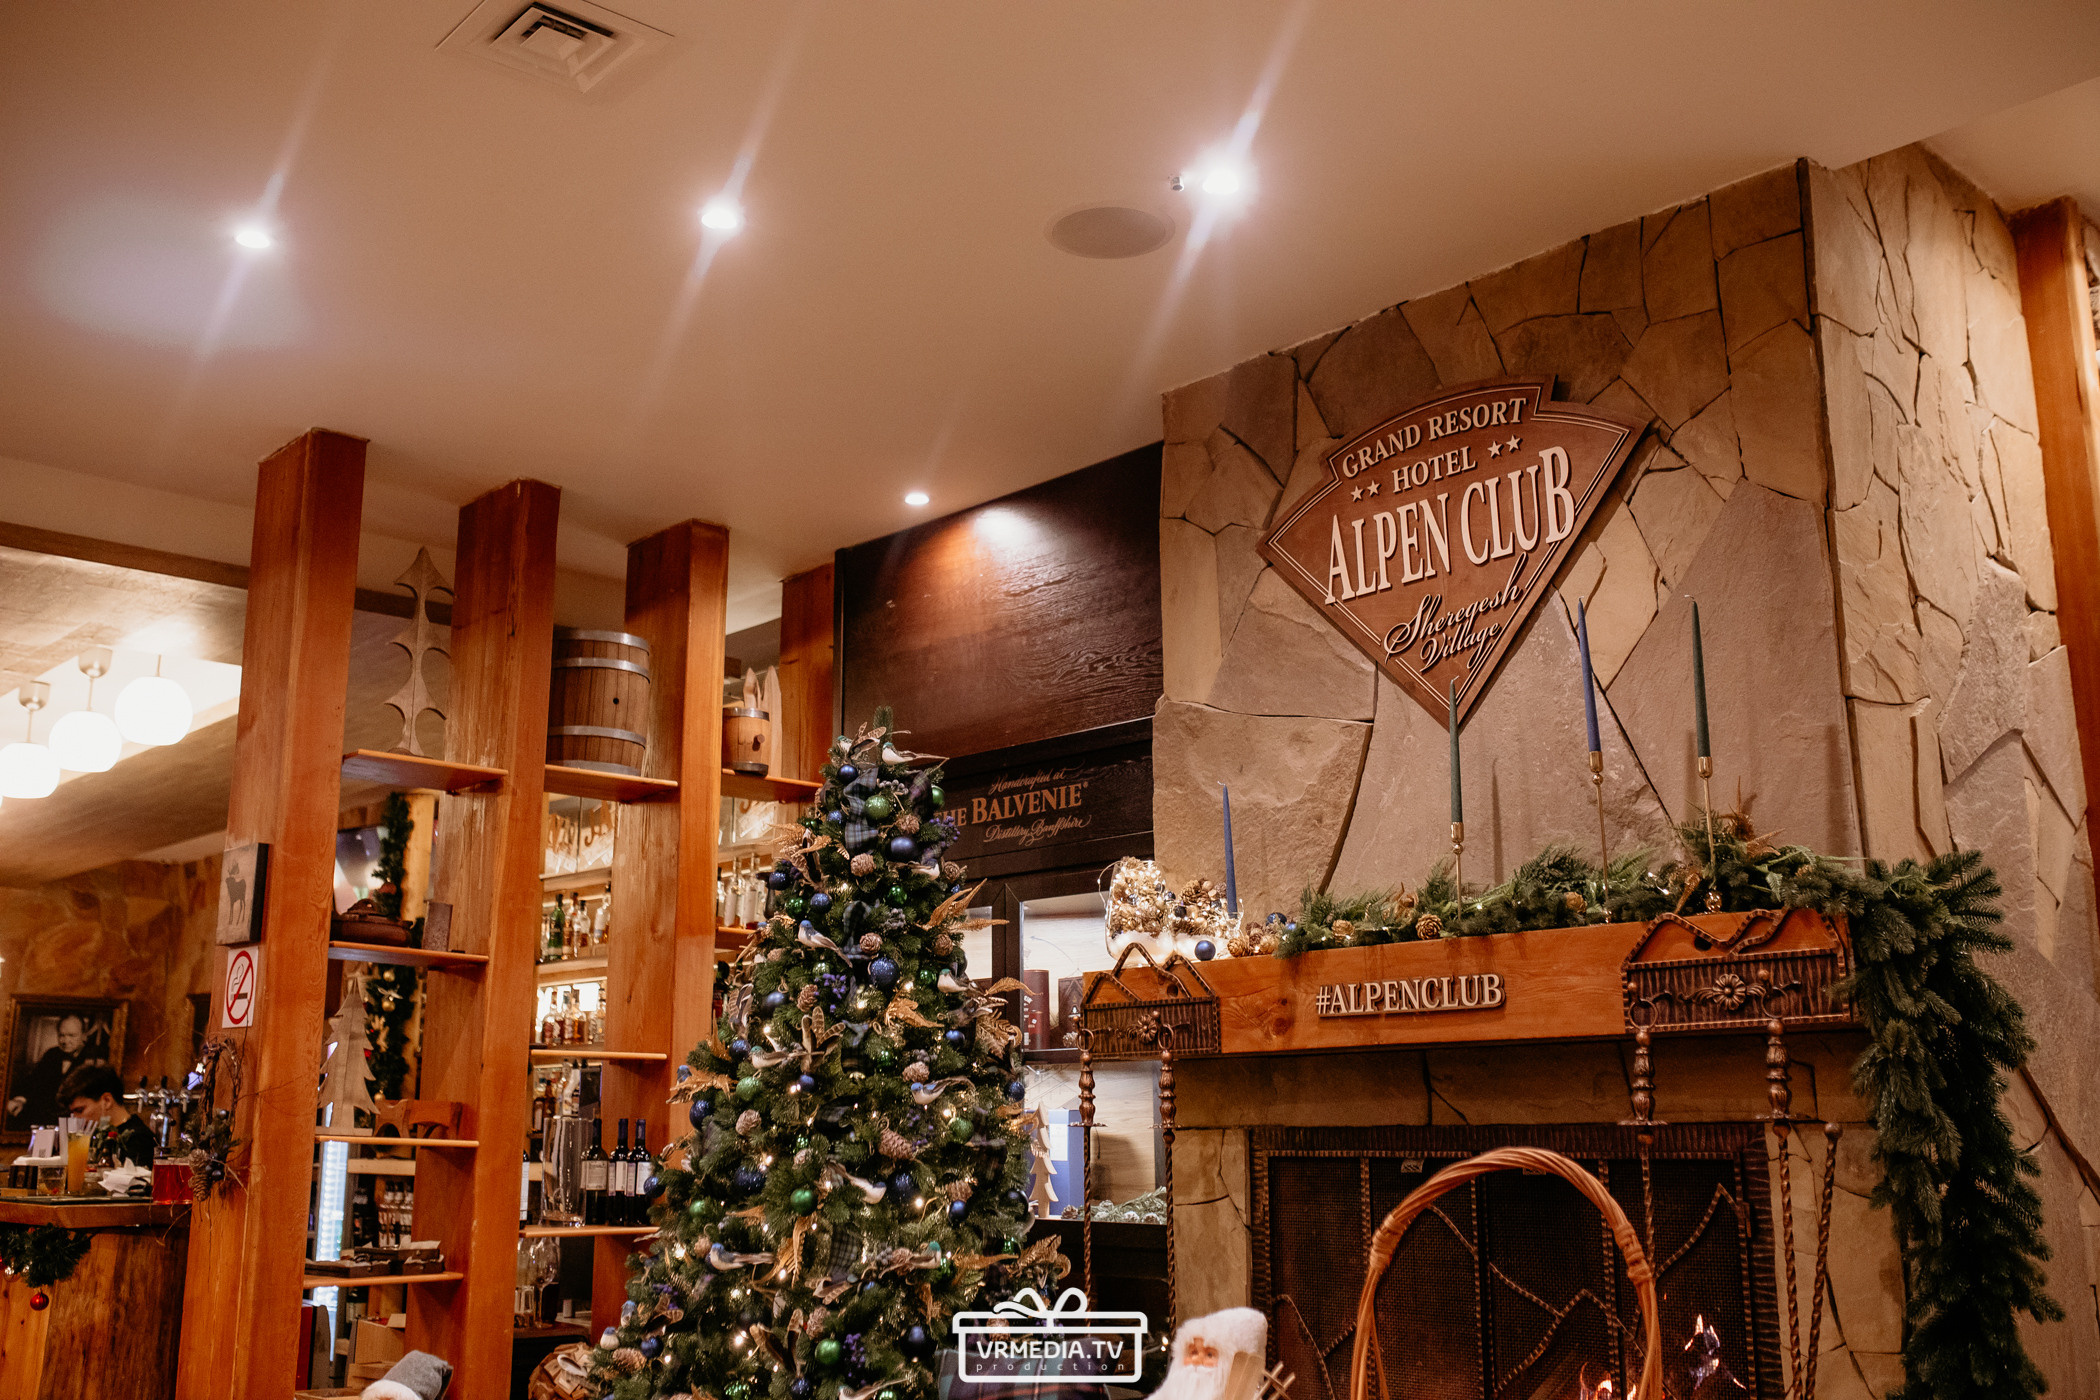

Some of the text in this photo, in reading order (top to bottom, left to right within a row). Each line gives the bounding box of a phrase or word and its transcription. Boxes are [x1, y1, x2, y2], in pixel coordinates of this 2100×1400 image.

[1342, 397, 1526, 478] GRAND RESORT
[1391, 446, 1476, 493] HOTEL
[1325, 446, 1576, 604] ALPEN CLUB
[1384, 551, 1526, 664] Sheregesh
[1420, 621, 1500, 672] Village
[988, 769, 1053, 795] Handcrafted
[1315, 973, 1503, 1015] #ALPENCLUB
